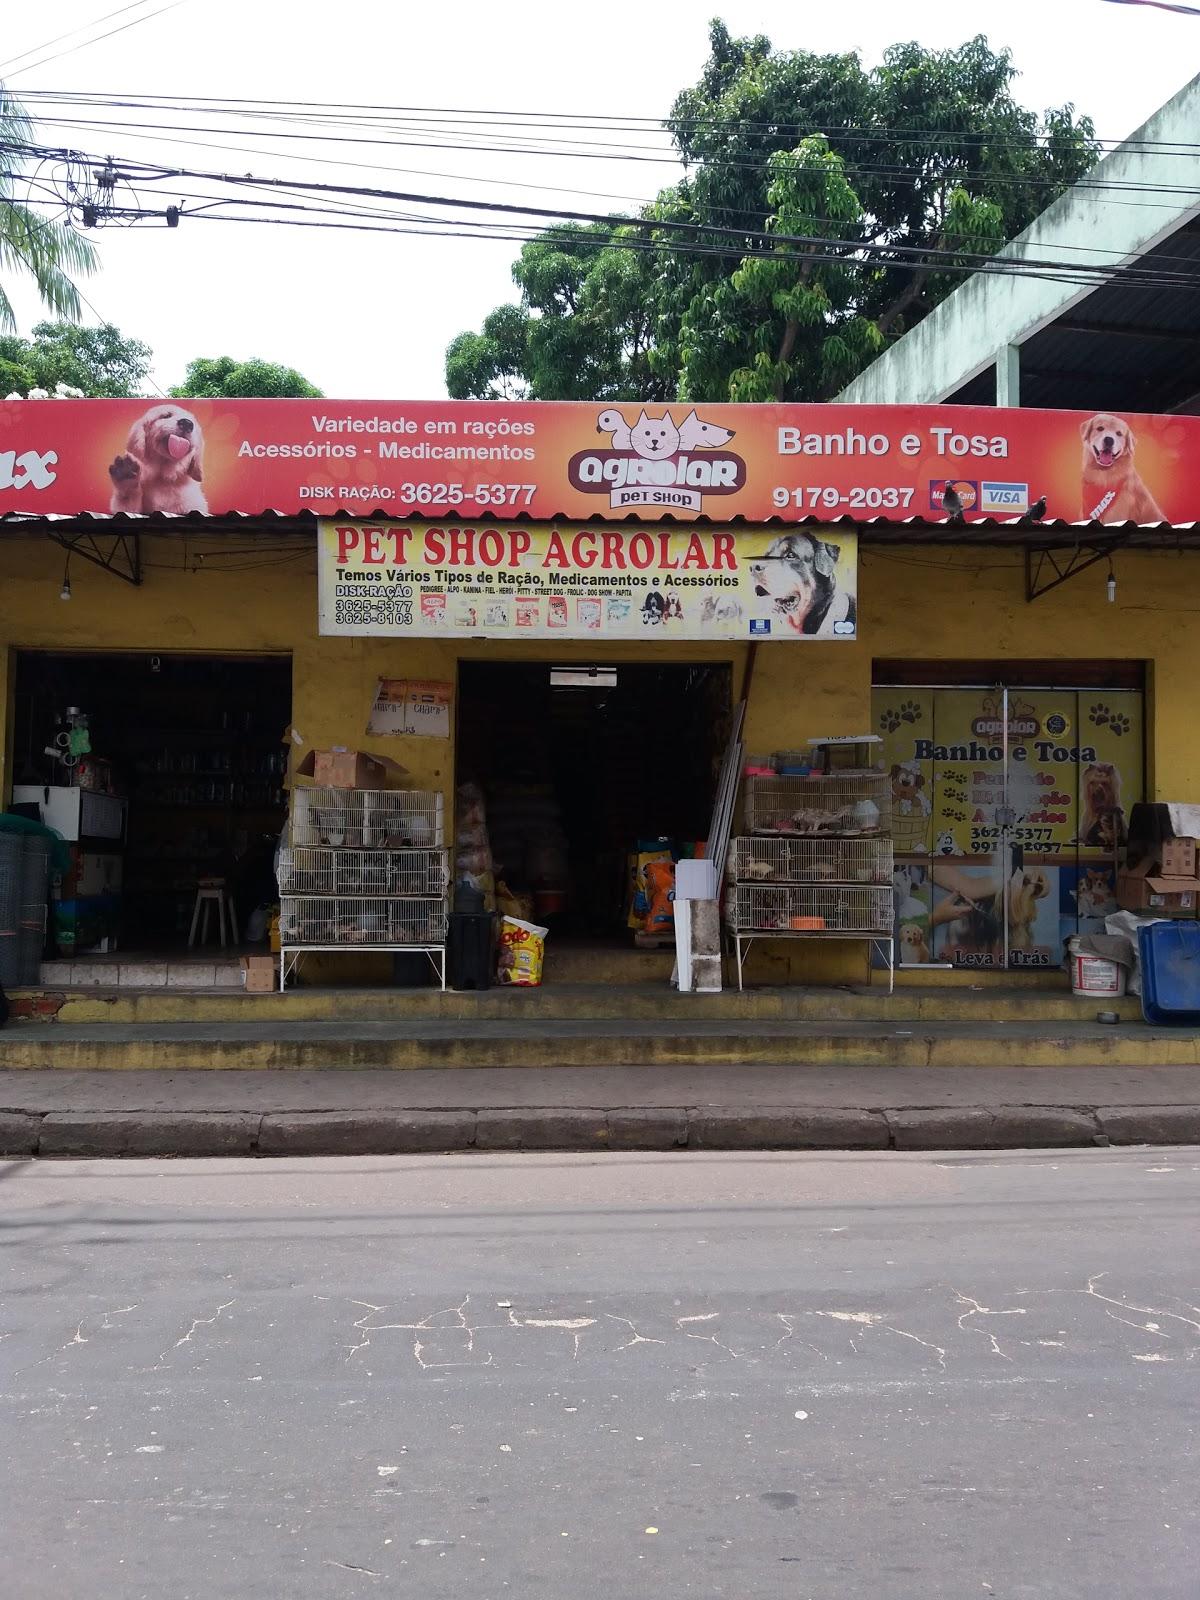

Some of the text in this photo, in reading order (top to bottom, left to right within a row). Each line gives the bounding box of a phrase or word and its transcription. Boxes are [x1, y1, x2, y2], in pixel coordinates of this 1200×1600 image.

[312, 416, 535, 439] Variedade em rações
[238, 441, 357, 458] Acessórios
[379, 442, 535, 460] Medicamentos
[778, 427, 1008, 458] Banho e Tosa
[299, 482, 537, 505] DISK RAÇÃO: 3625-5377
[773, 487, 915, 508] 9179-2037
[932, 490, 976, 500] MaCard
[989, 491, 1020, 503] VISA
[335, 527, 739, 570] PET SHOP AGROLAR
[336, 569, 739, 588] Temos Vários Tipos de Ração, Medicamentos e Acessórios
[336, 584, 413, 600] DISK-RAÇÃO
[463, 586, 481, 594] KANINA
[499, 586, 513, 595] HERÓI
[534, 588, 552, 596] STREET
[598, 589, 612, 597] SHOW
[616, 589, 632, 597] PAPITA
[336, 599, 413, 612] 3625-5377
[336, 612, 413, 625] 3625-8103
[914, 739, 1097, 762] Banho e Tosa
[955, 949, 993, 964] Leva
[1011, 949, 1049, 964] Trás
